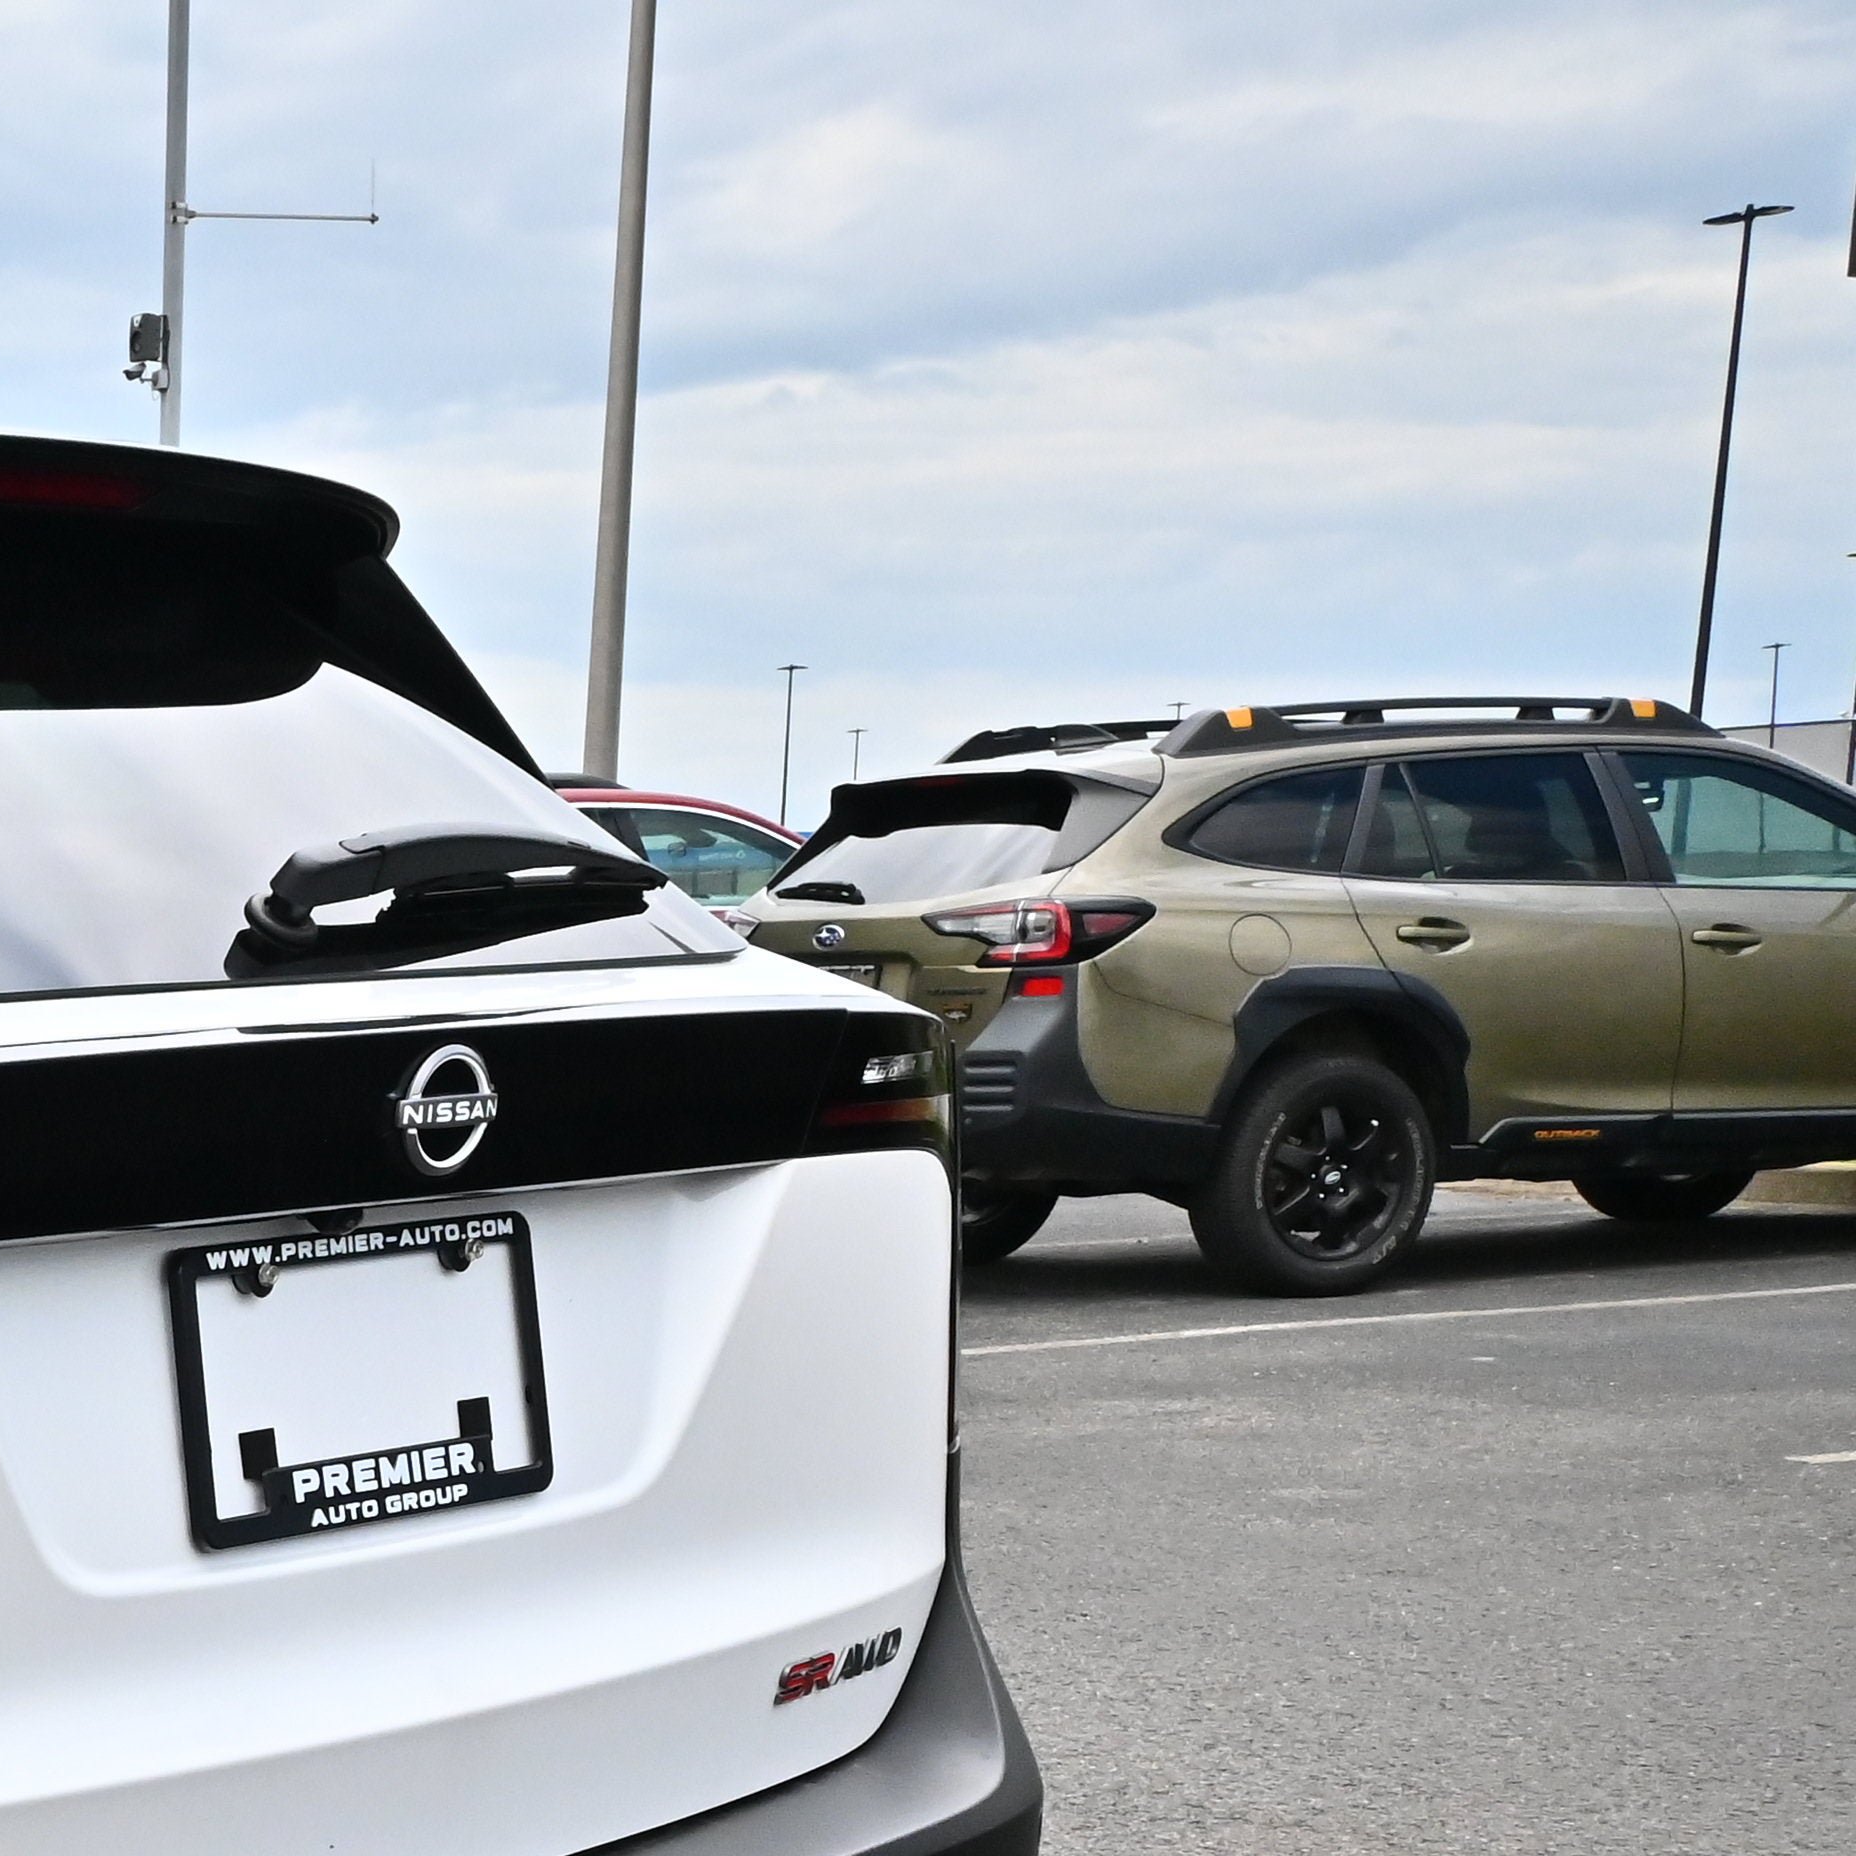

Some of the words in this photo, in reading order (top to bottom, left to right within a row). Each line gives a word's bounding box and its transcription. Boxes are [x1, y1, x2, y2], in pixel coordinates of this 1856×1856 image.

[402, 1096, 498, 1126] NISSAN
[205, 1218, 514, 1271] WWW.PREMIER-AUTO.COM
[291, 1442, 477, 1504] PREMIER
[310, 1500, 379, 1528] AUTO
[384, 1483, 469, 1514] GROUP
[774, 1652, 836, 1707] SR
